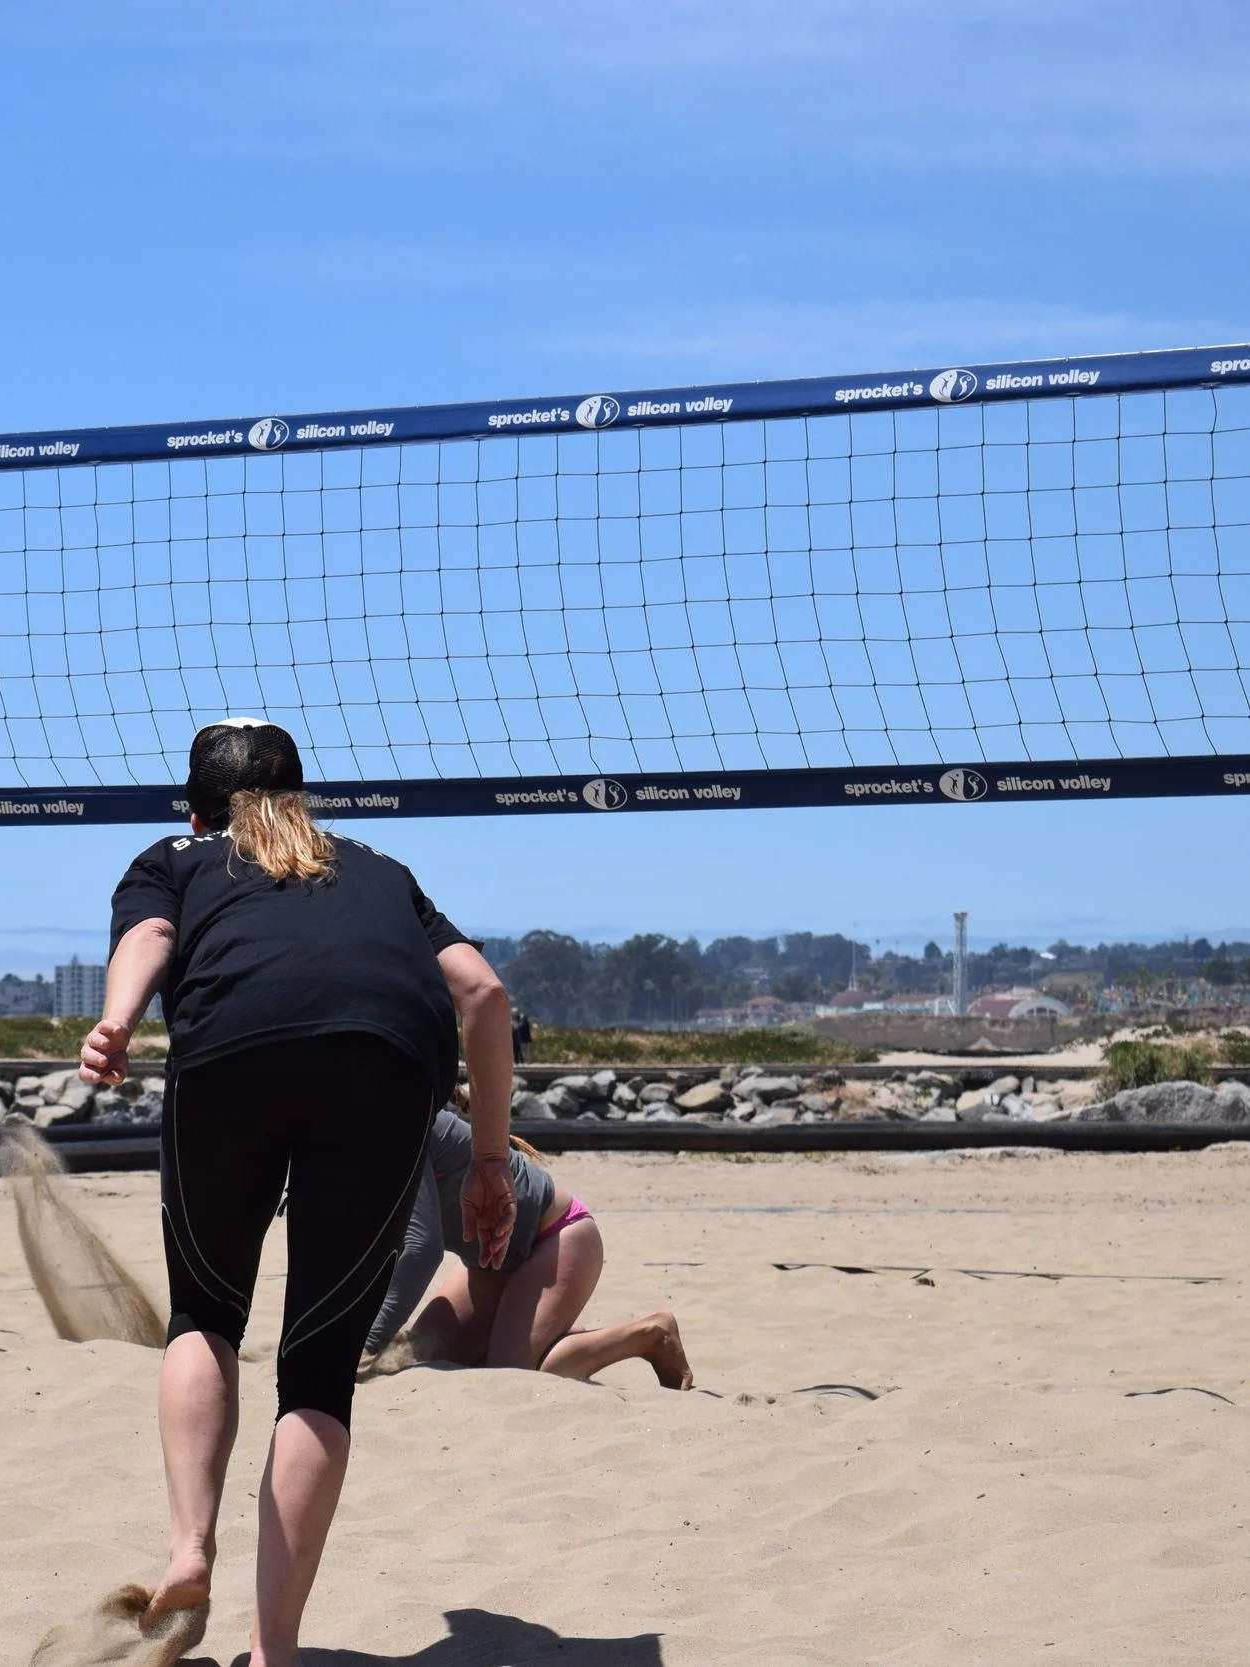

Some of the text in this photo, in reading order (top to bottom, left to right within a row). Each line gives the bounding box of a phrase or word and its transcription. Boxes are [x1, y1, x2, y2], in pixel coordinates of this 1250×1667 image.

[835, 369, 1100, 403] sprocket's silicon volley
[488, 397, 733, 428] sprocket's silicon volley
[167, 421, 394, 449] sprocket's silicon volley
[39, 442, 79, 456] volley
[496, 785, 740, 805] sprocket's silicon volley
[845, 775, 1110, 796] sprocket's silicon volley
[43, 800, 83, 815] volley
[307, 794, 399, 809] silicon volley
